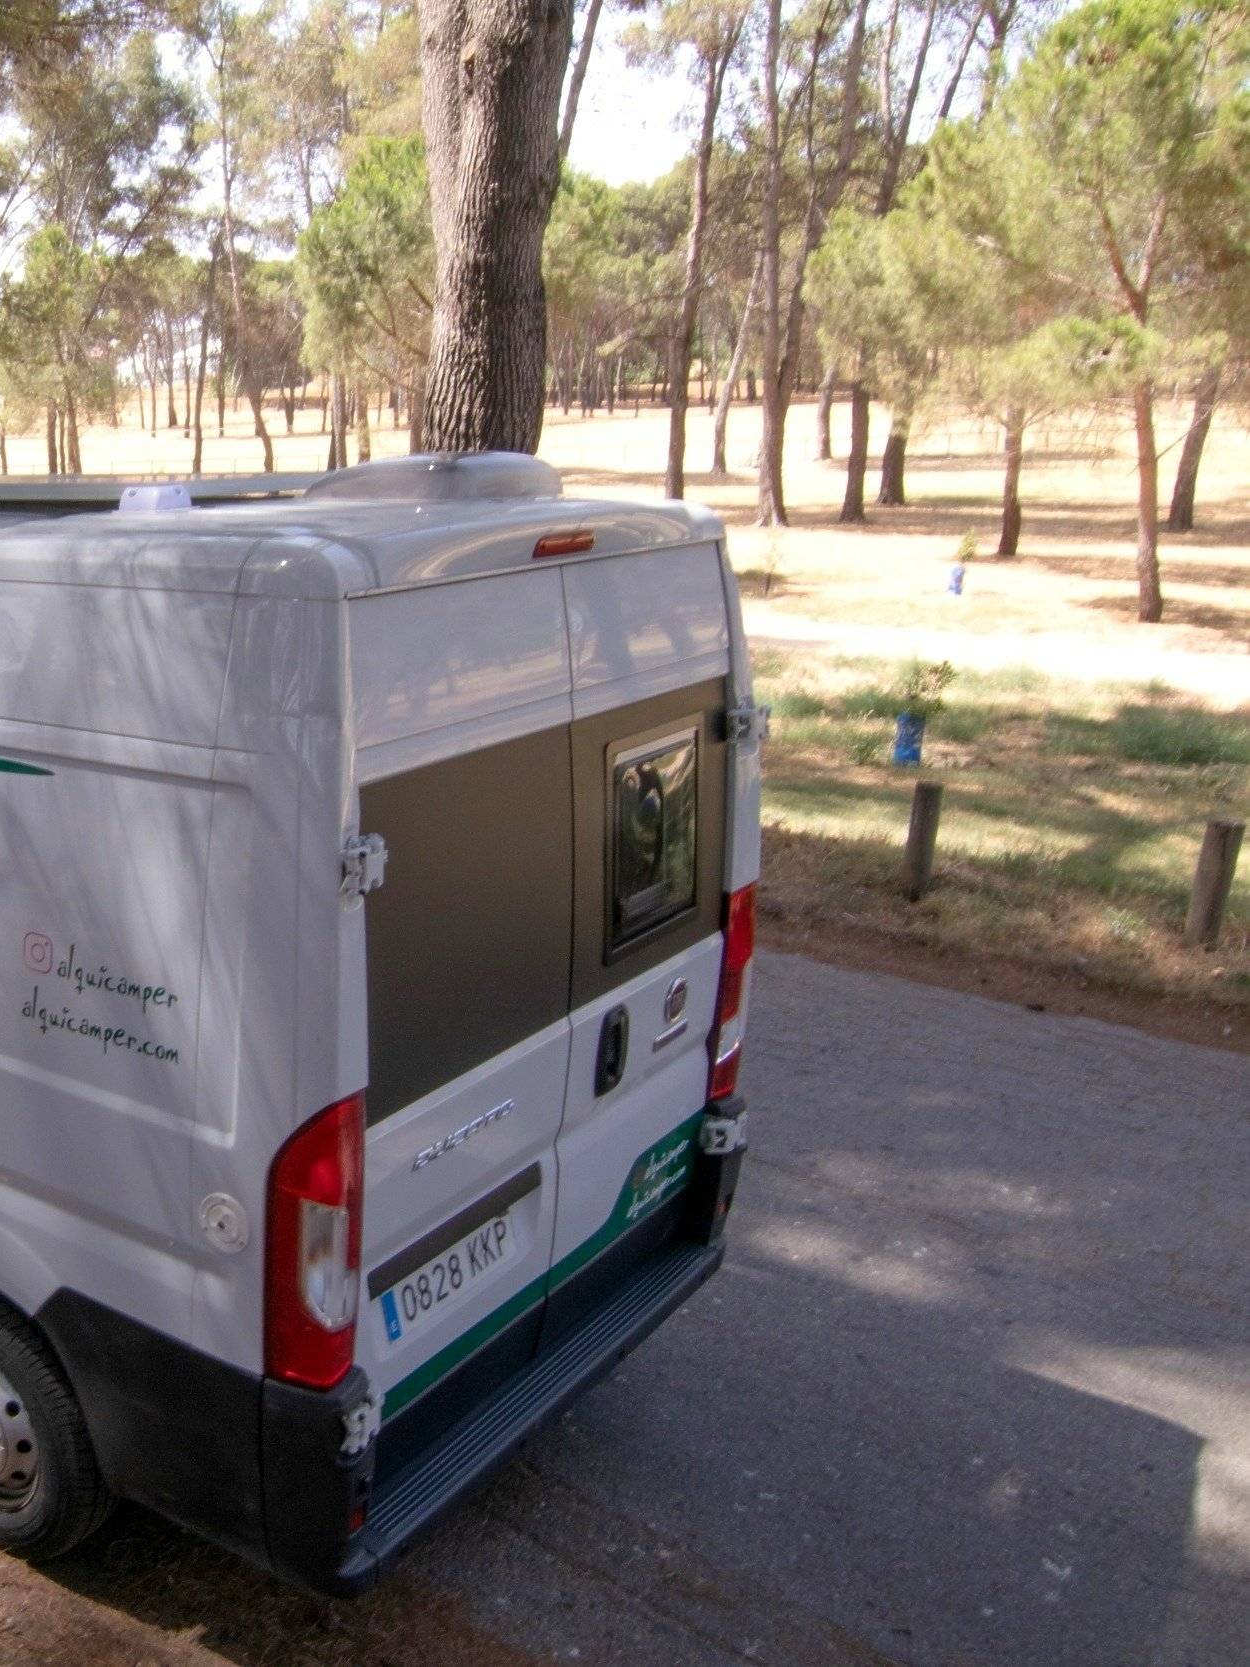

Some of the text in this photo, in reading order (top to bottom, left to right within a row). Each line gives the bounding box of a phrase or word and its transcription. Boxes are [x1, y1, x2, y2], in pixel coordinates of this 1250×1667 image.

[57, 944, 178, 1014] alquicamper
[22, 985, 180, 1064] alquicamper.com
[401, 1253, 464, 1322] 0828
[466, 1219, 507, 1277] KKP
